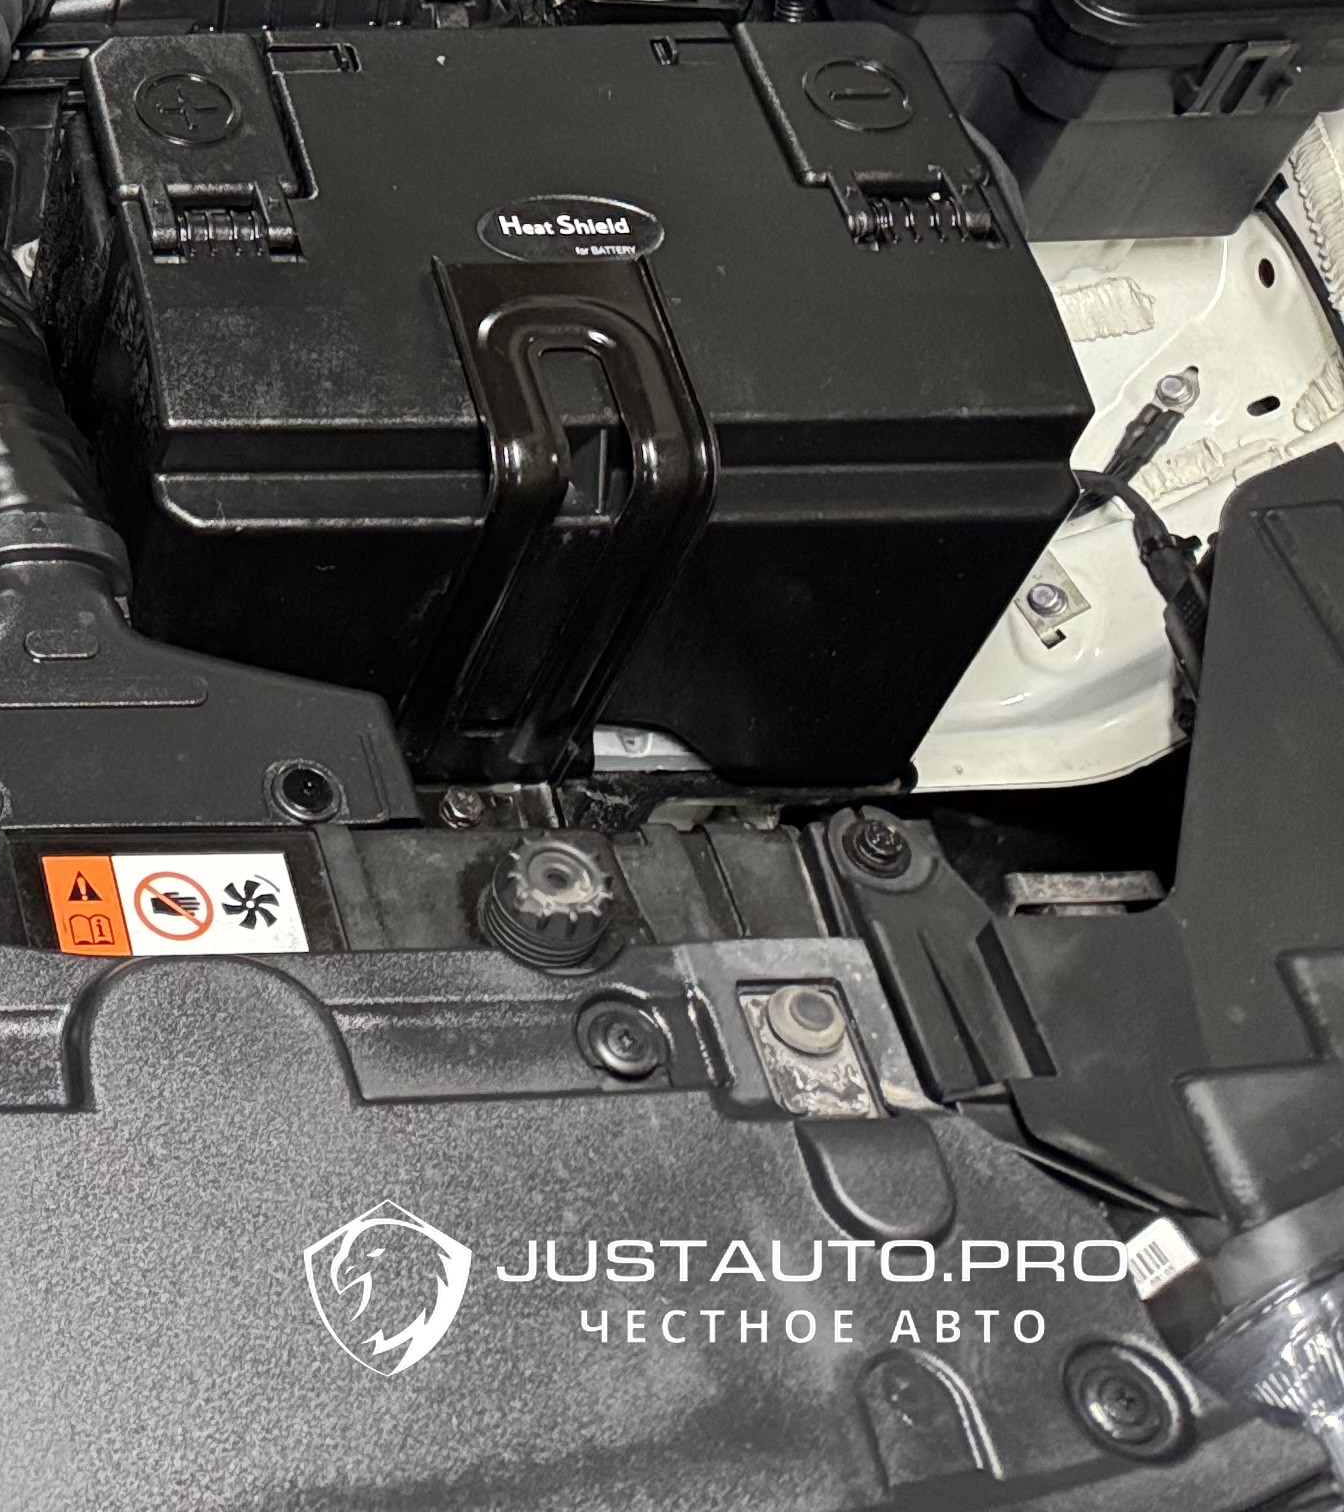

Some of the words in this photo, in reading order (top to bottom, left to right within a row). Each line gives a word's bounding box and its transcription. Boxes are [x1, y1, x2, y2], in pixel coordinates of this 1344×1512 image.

[498, 215, 555, 236] Heat
[556, 214, 630, 235] Shield
[575, 246, 589, 256] for
[590, 245, 636, 256] BATTERY
